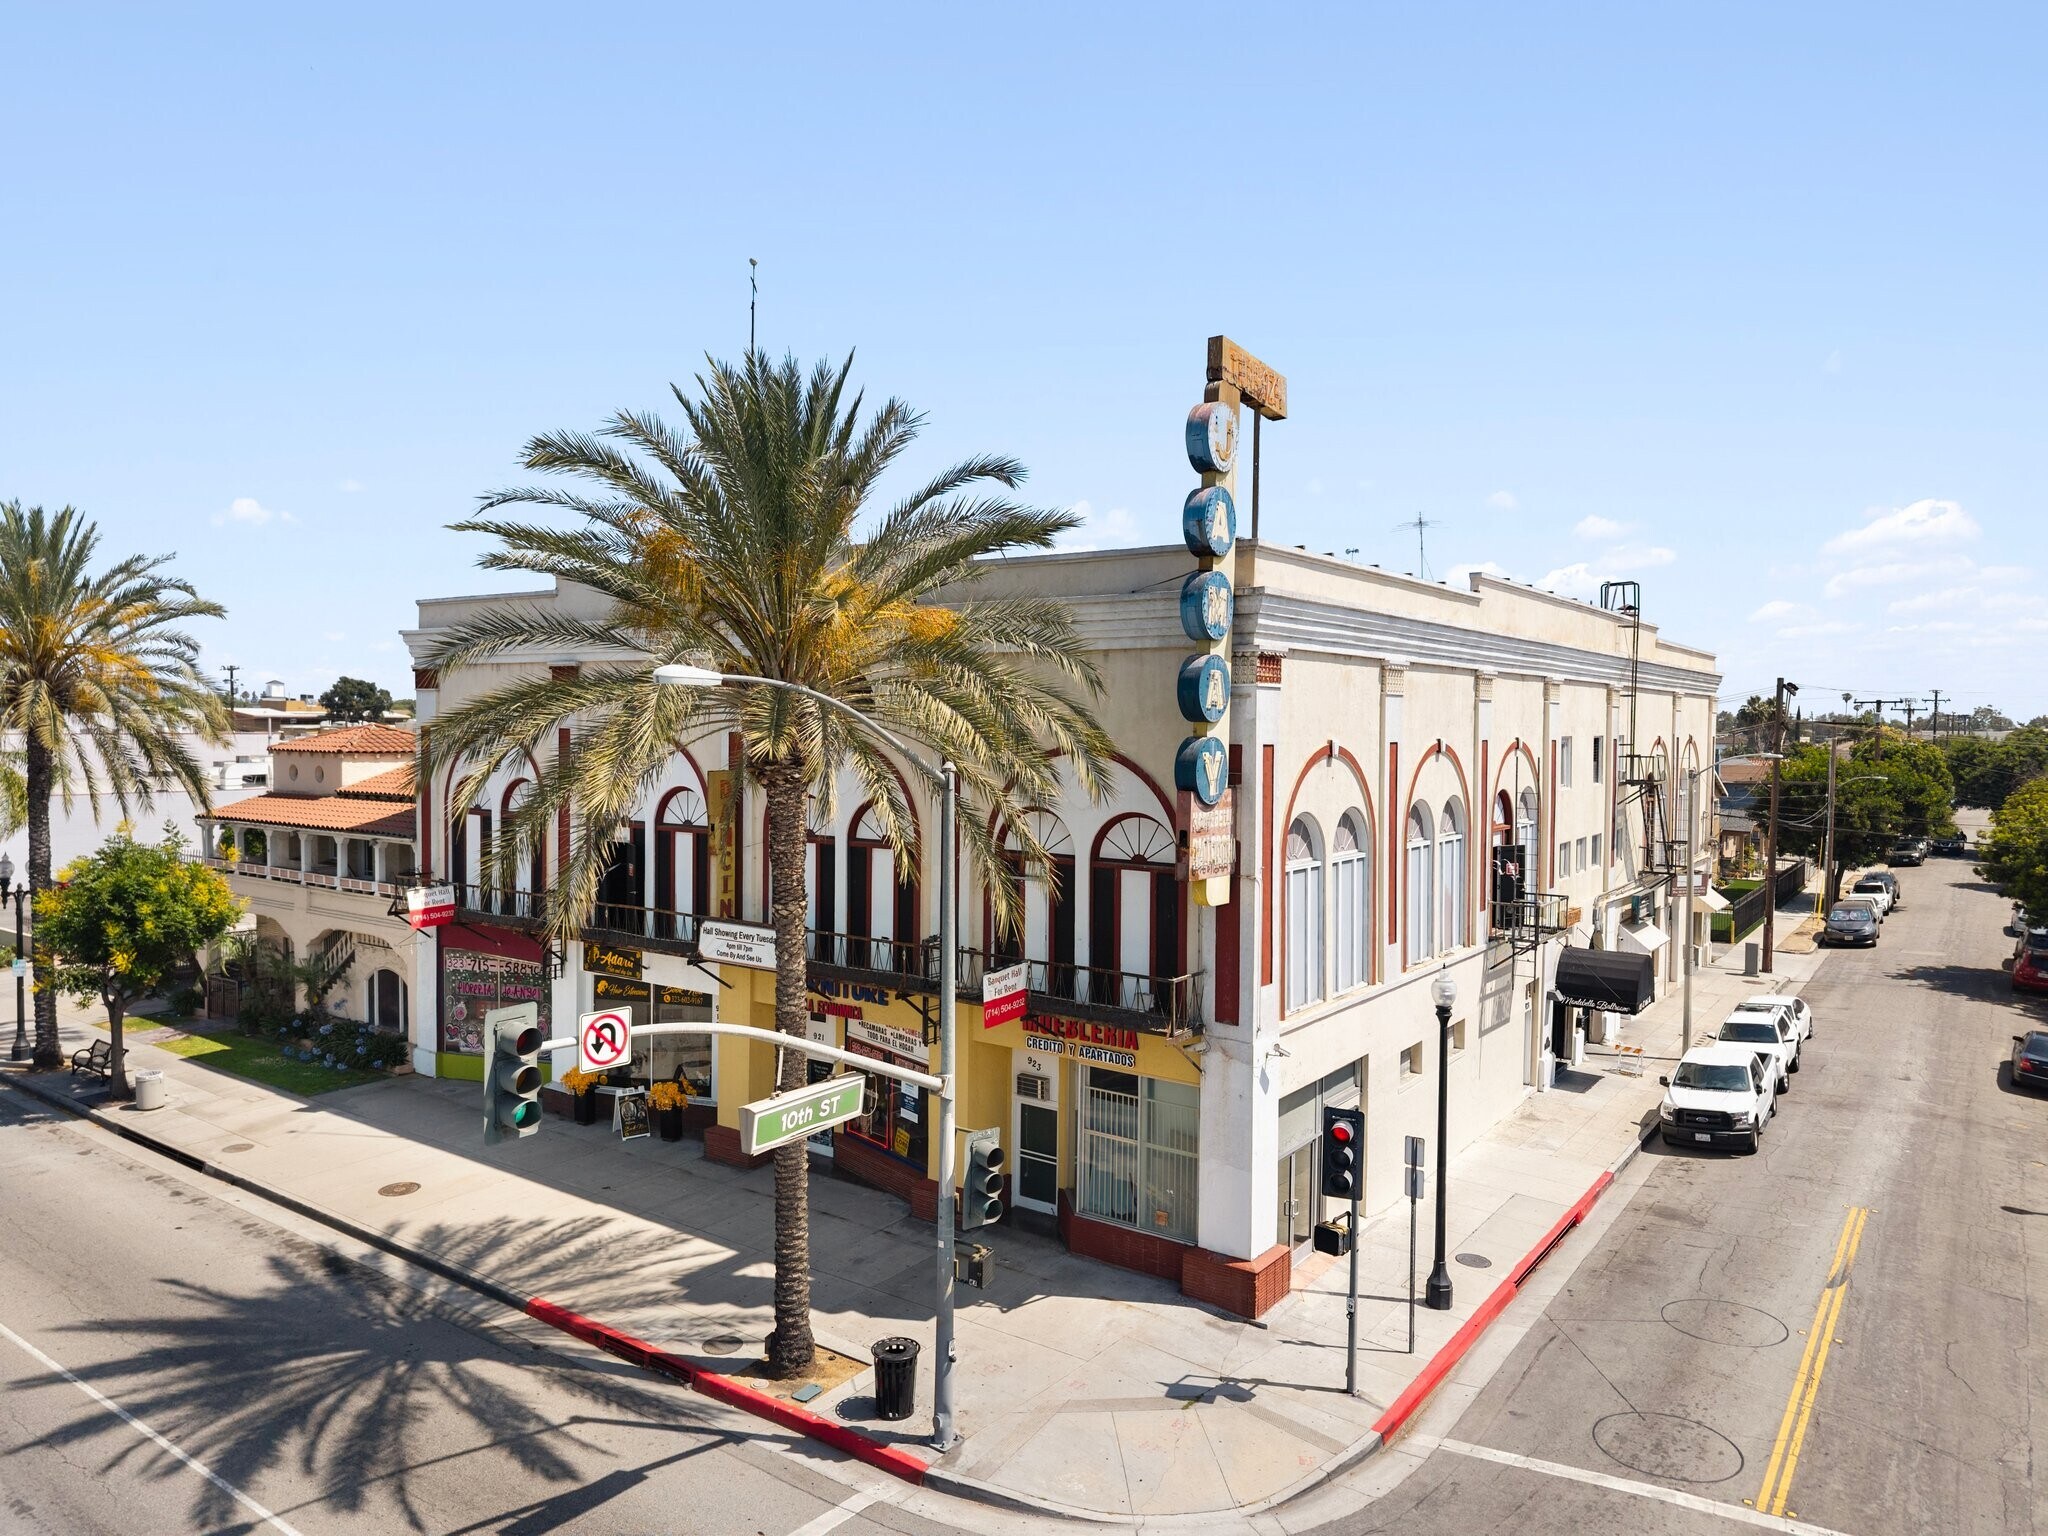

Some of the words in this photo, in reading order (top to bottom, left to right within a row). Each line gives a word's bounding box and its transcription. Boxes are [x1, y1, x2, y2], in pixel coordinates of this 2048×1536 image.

[439, 888, 450, 896] Hall
[702, 926, 714, 935] Hall
[714, 928, 738, 940] Showing
[738, 931, 756, 943] Every
[716, 949, 729, 958] Come
[729, 951, 736, 960] By
[755, 955, 763, 963] Us
[726, 942, 736, 950] 4pm
[743, 945, 754, 953] 7pm
[987, 972, 1010, 988] Banquet
[1011, 966, 1022, 978] Hall
[994, 986, 1003, 997] For
[1003, 982, 1018, 994] Rent
[817, 1000, 863, 1020] ECONOMICA
[985, 1006, 1000, 1021] (714)
[1000, 998, 1026, 1015] 504-9232
[813, 1032, 825, 1041] 921
[867, 1030, 879, 1041] TODO
[879, 1035, 891, 1045] PARA
[892, 1039, 898, 1048] EL
[899, 1042, 915, 1053] HOGAR
[1022, 1015, 1139, 1051] MUEBLERIA
[1026, 1036, 1065, 1055] CREDITO
[1068, 1043, 1076, 1057] Y
[1078, 1045, 1136, 1068] APARTADOS
[1027, 1056, 1042, 1072] 923
[781, 1106, 813, 1132] 10th
[819, 1095, 841, 1117] ST
